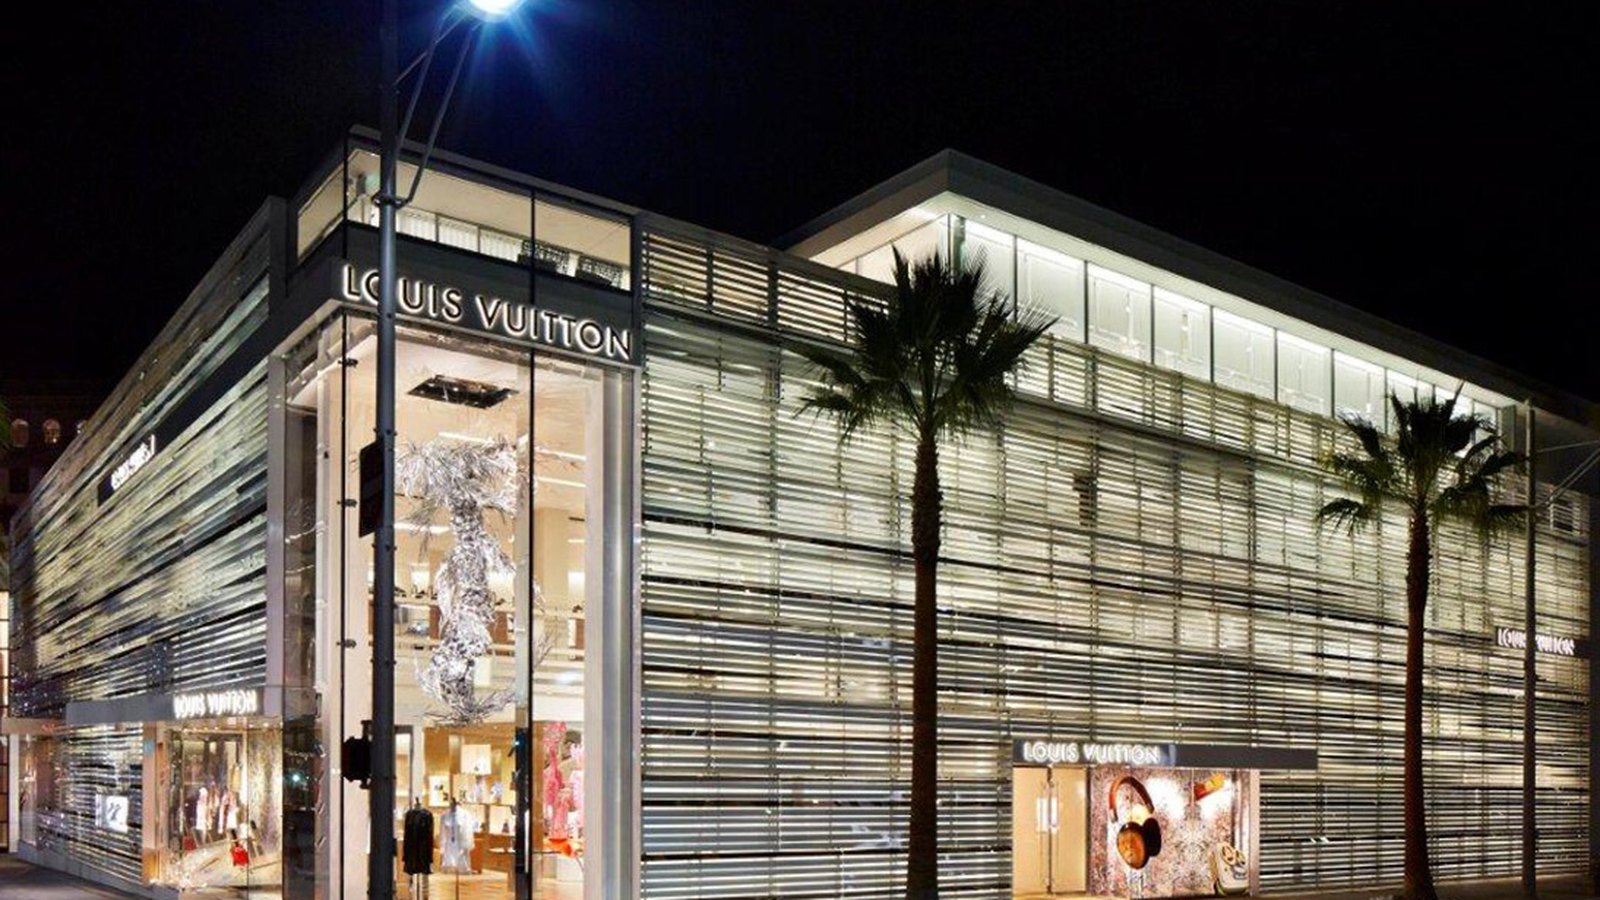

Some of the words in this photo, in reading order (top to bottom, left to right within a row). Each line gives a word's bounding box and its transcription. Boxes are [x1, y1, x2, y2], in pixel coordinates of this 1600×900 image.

[342, 264, 463, 322] LOUIS
[475, 294, 632, 361] VUITTON
[1023, 741, 1080, 763] LOUIS
[1083, 743, 1161, 765] VUITTON
